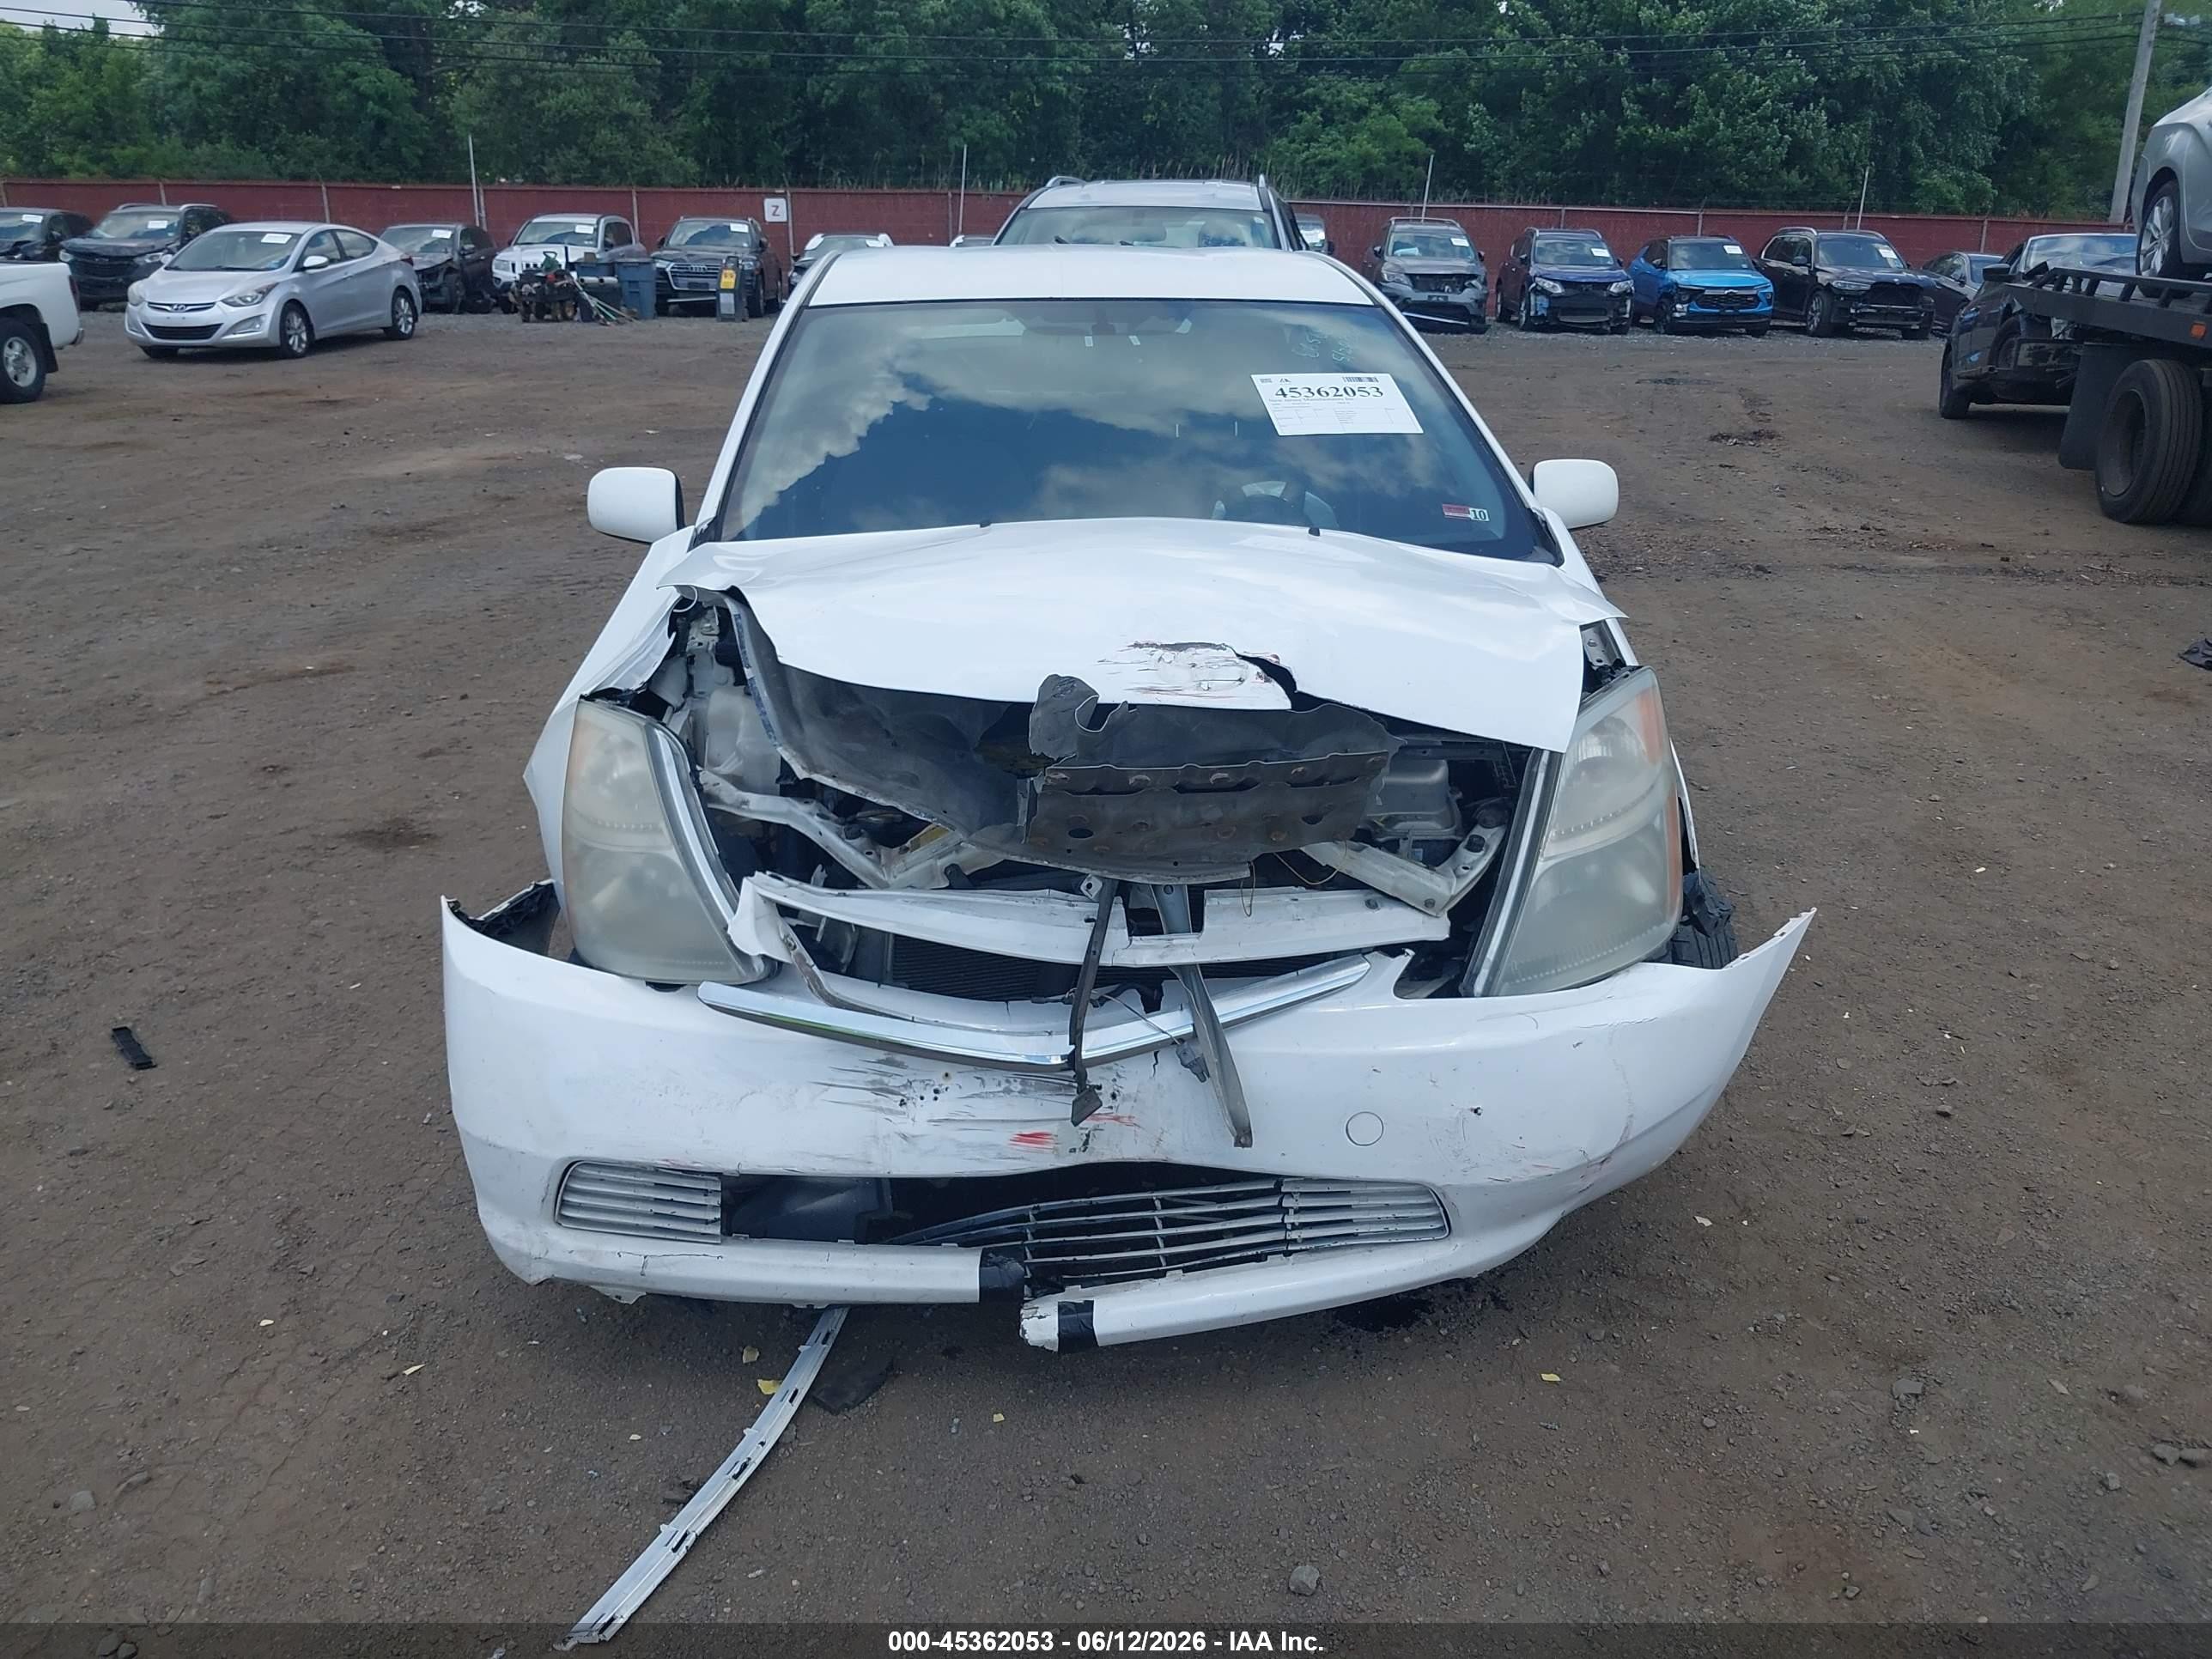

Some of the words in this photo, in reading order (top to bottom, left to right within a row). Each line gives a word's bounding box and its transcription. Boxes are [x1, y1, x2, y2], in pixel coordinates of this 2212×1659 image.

[771, 204, 780, 216] Z
[1275, 386, 1383, 398] 45362053
[1471, 509, 1486, 520] 10
